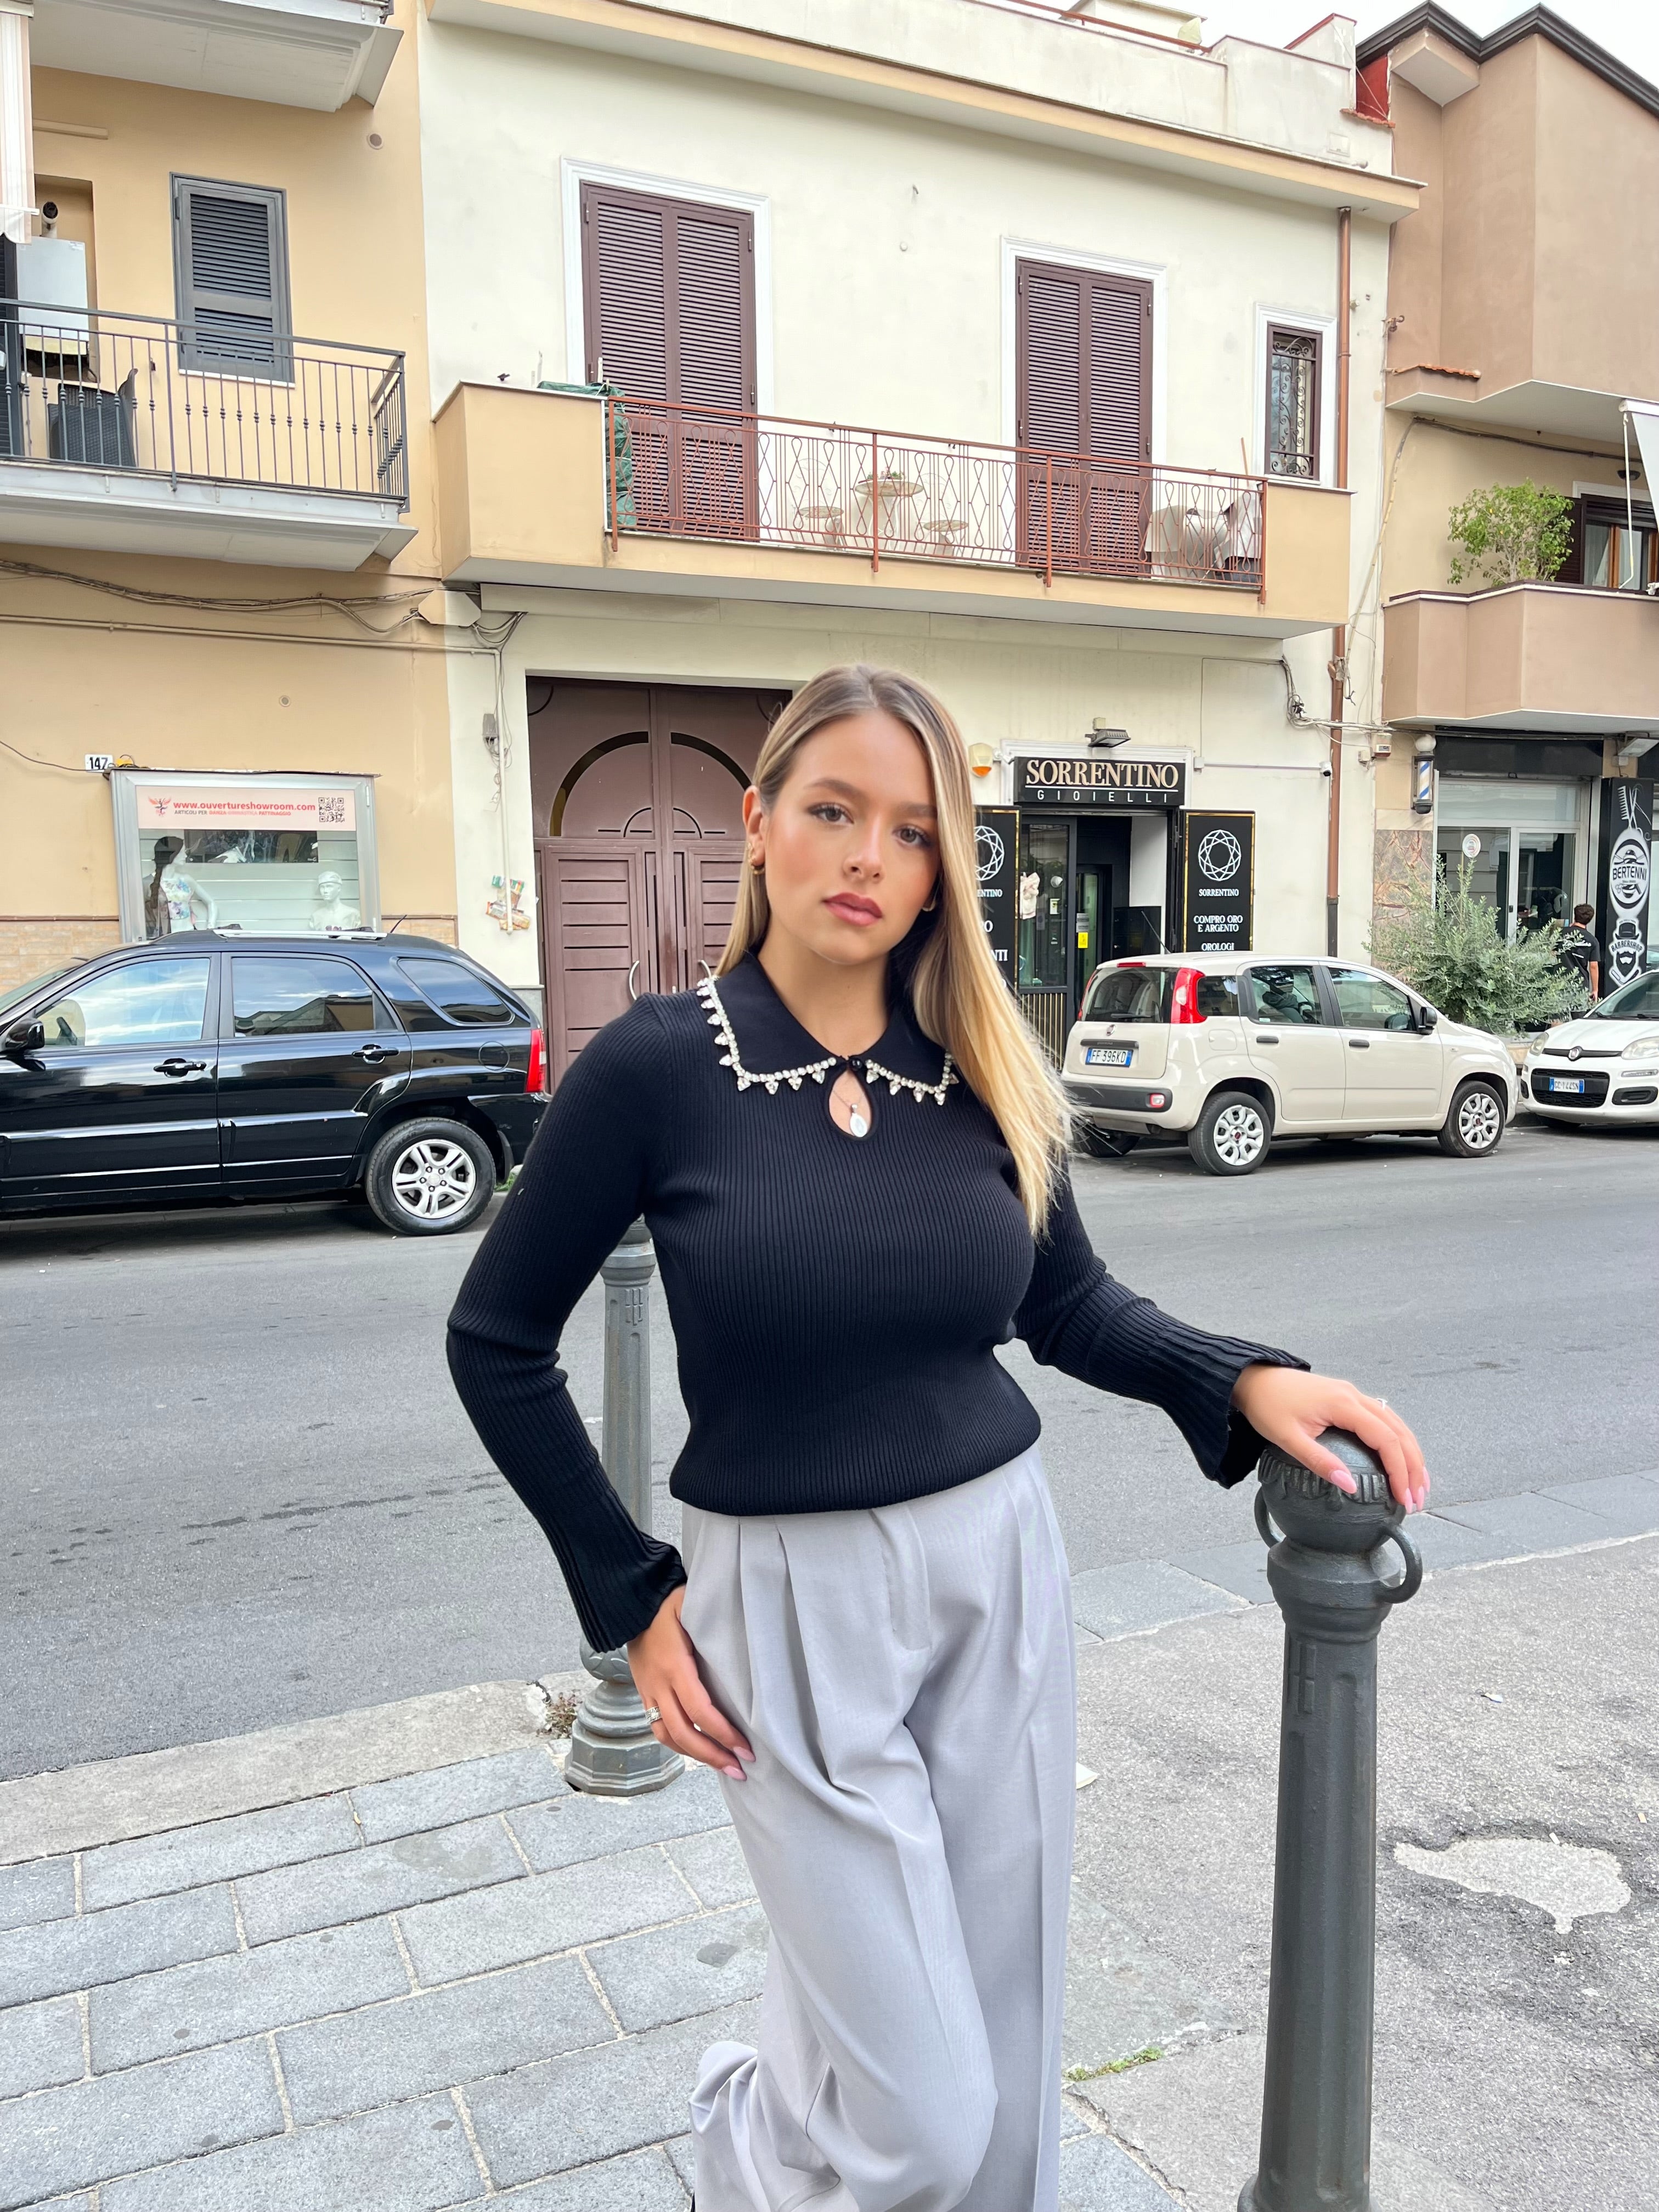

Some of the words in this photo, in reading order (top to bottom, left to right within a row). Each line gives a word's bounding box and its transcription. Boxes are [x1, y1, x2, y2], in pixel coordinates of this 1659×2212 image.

[90, 757, 108, 770] 147
[1026, 759, 1179, 788] SORRENTINO
[1037, 790, 1167, 803] GIOIELLI
[173, 802, 315, 810] www.ouvertureshowroom.com
[1613, 866, 1647, 881] BERTENNI
[977, 889, 1003, 898] ENTINO
[1194, 915, 1226, 924] COMPRO
[1227, 915, 1243, 923] ORO
[1198, 924, 1203, 932] E
[1204, 923, 1239, 932] ARGENTO
[1201, 943, 1235, 951] OROLOGI
[1611, 940, 1643, 952] BARBERSHOP
